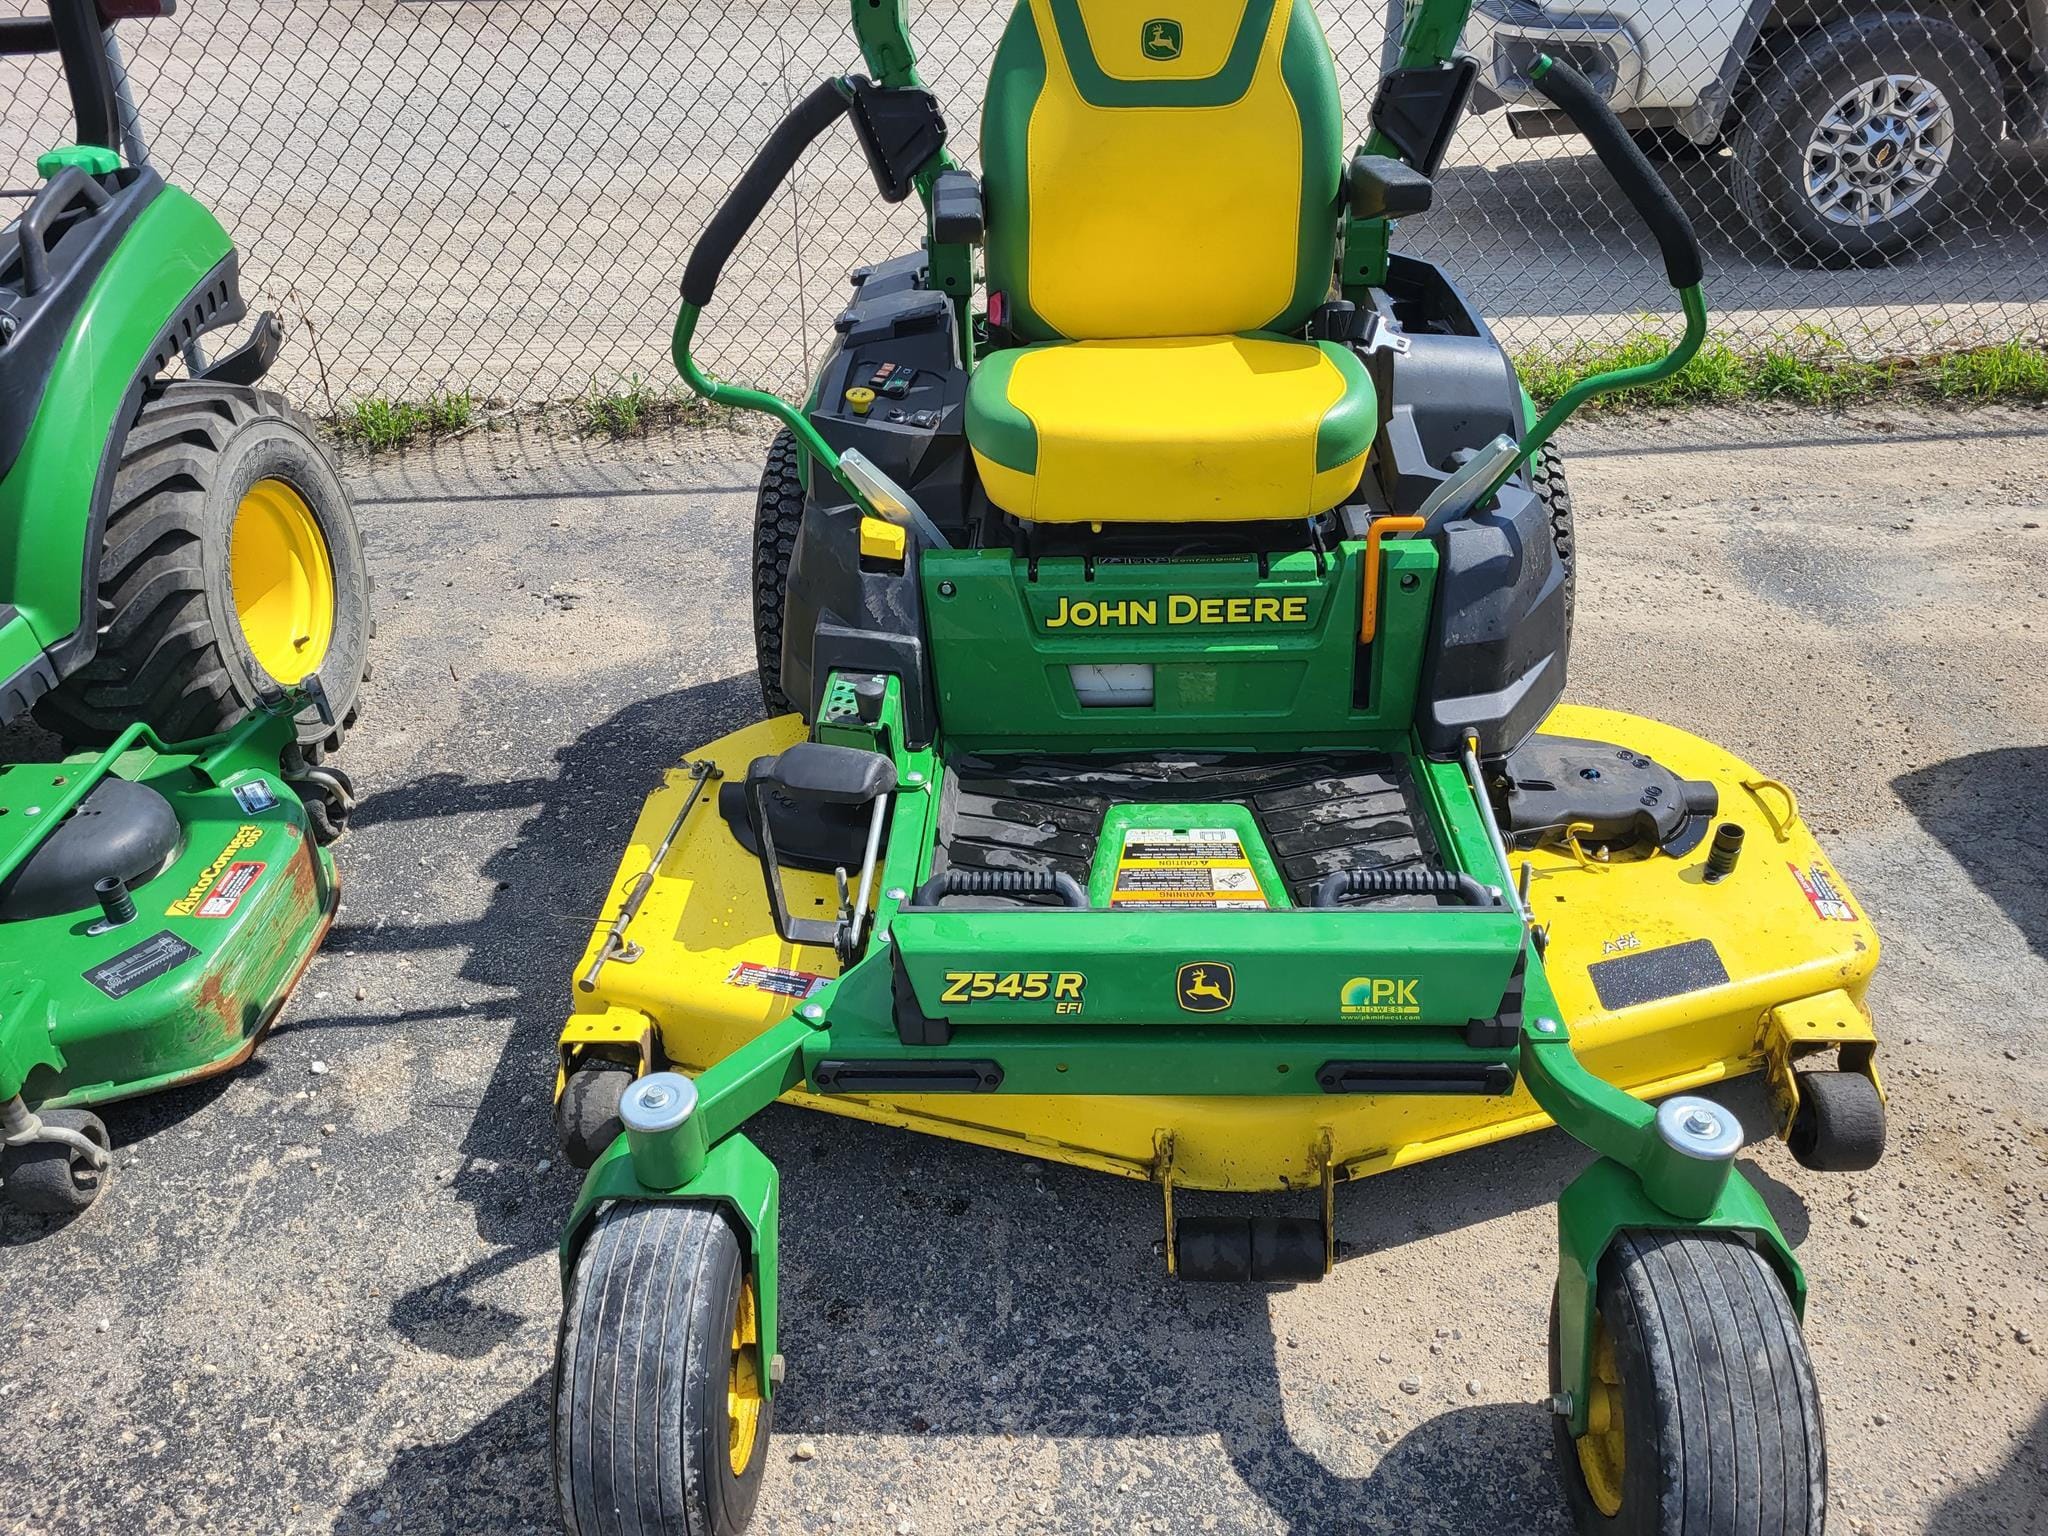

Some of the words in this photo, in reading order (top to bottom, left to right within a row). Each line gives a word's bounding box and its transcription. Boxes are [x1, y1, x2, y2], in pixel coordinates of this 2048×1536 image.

[1046, 597, 1158, 628] JOHN
[1168, 595, 1307, 625] DEERE
[179, 824, 257, 913] AutoConnect
[1372, 979, 1419, 1005] P&K
[1055, 1002, 1083, 1014] EFI
[1355, 1006, 1405, 1014] MIDWEST
[1340, 1014, 1421, 1022] www.pkmidwest.com
